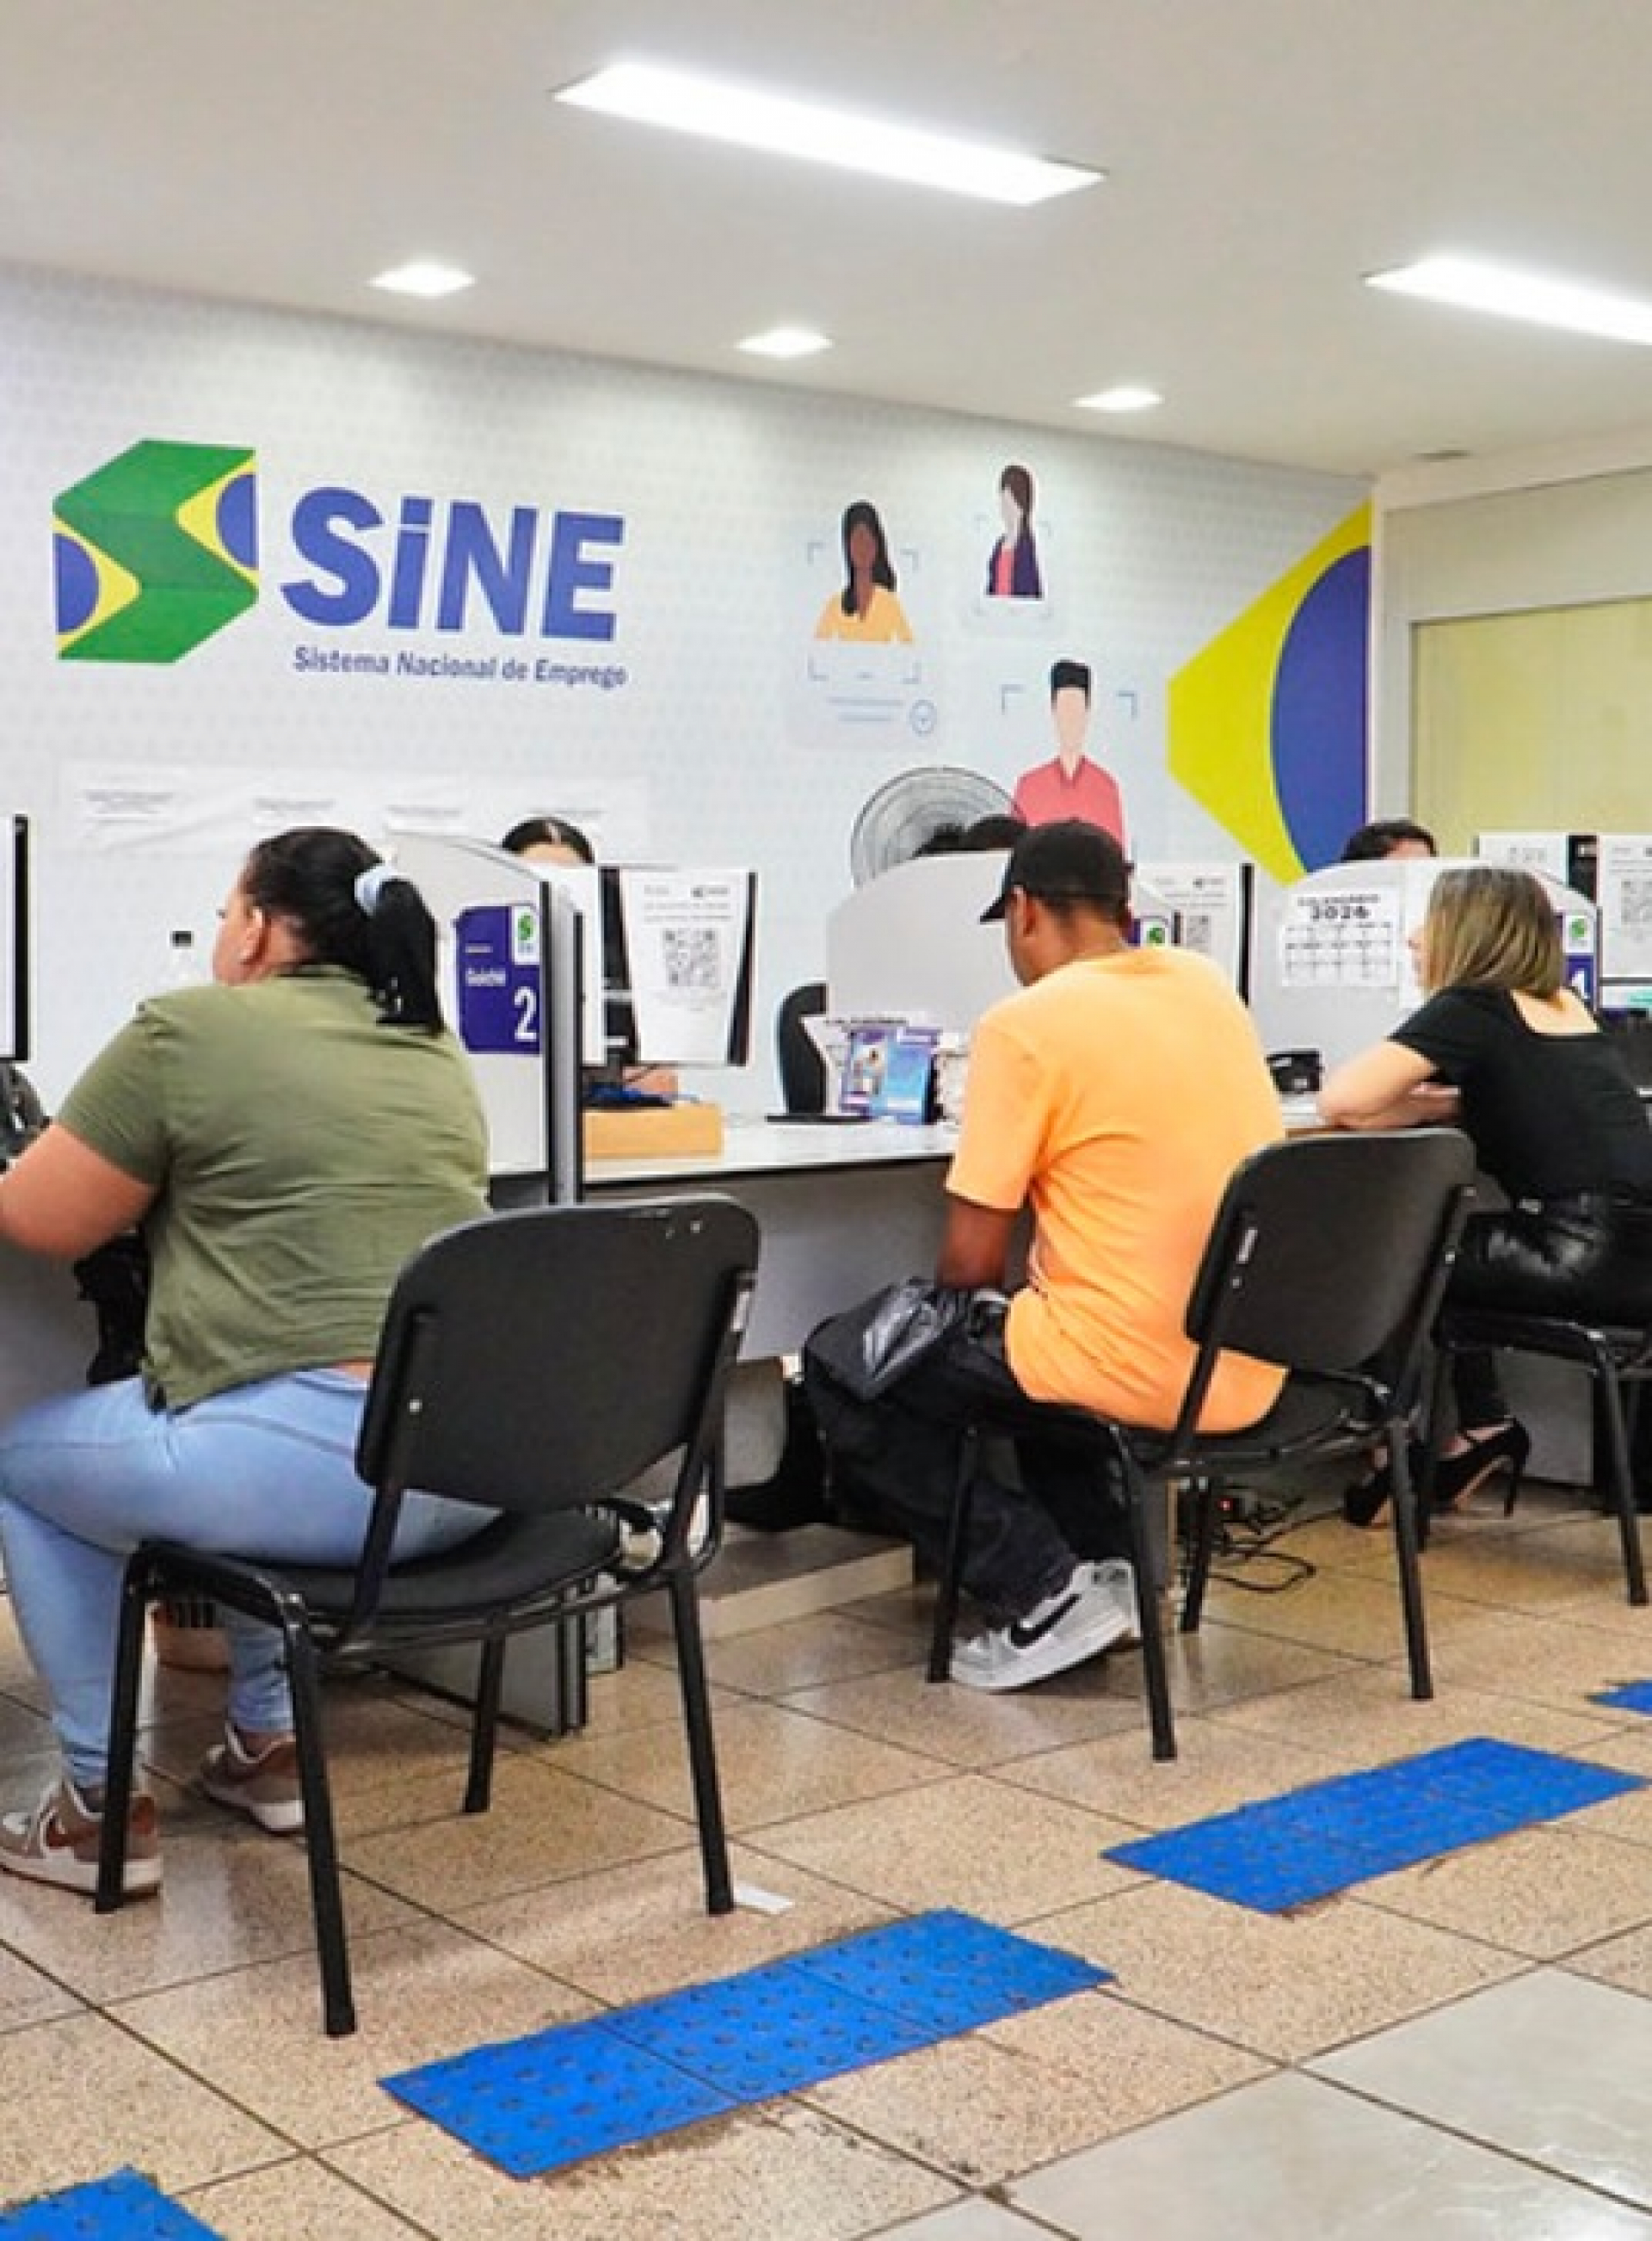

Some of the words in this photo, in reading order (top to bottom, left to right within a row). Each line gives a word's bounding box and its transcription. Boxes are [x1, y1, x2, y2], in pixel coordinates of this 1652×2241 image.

[293, 645, 390, 674] Sistema
[397, 650, 497, 679] Nacional
[502, 656, 527, 681] de
[534, 658, 628, 690] Emprego
[514, 985, 538, 1042] 2
